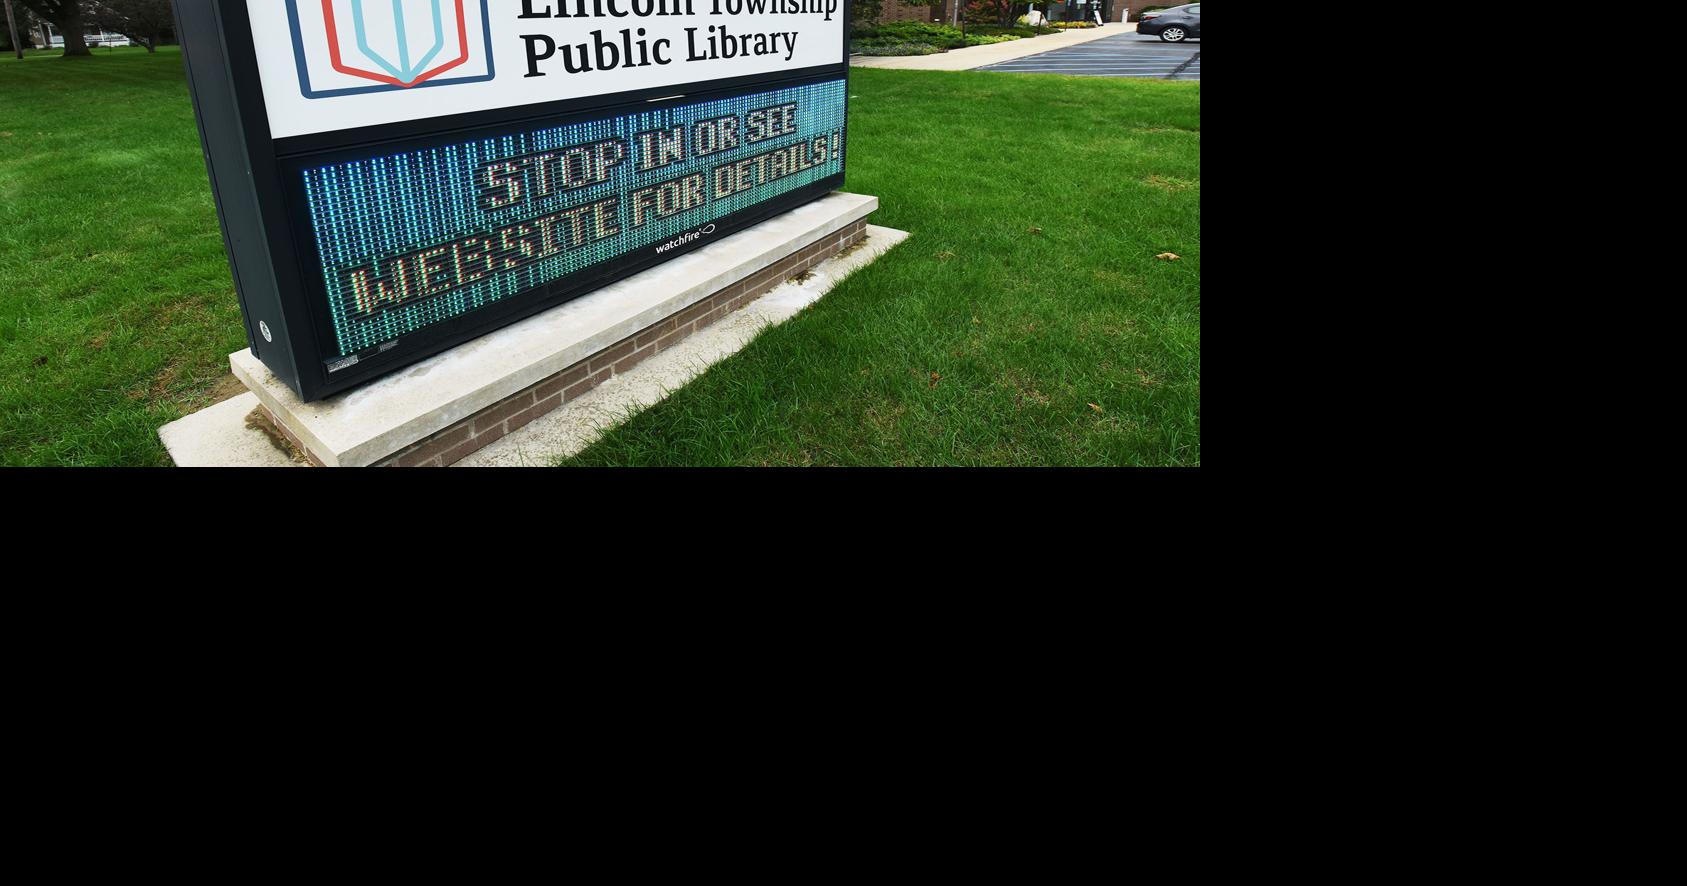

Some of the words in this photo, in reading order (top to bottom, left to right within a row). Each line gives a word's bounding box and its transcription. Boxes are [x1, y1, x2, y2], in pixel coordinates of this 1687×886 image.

[519, 27, 672, 78] Public
[683, 24, 799, 62] Library
[482, 141, 624, 207] STOP
[639, 128, 683, 169] IN
[695, 116, 738, 154] OR
[747, 103, 798, 142] SEE
[350, 198, 620, 315] WEBSITE
[633, 173, 704, 226] FOR
[714, 128, 840, 200] DETAILS!
[655, 231, 700, 254] watchfire
